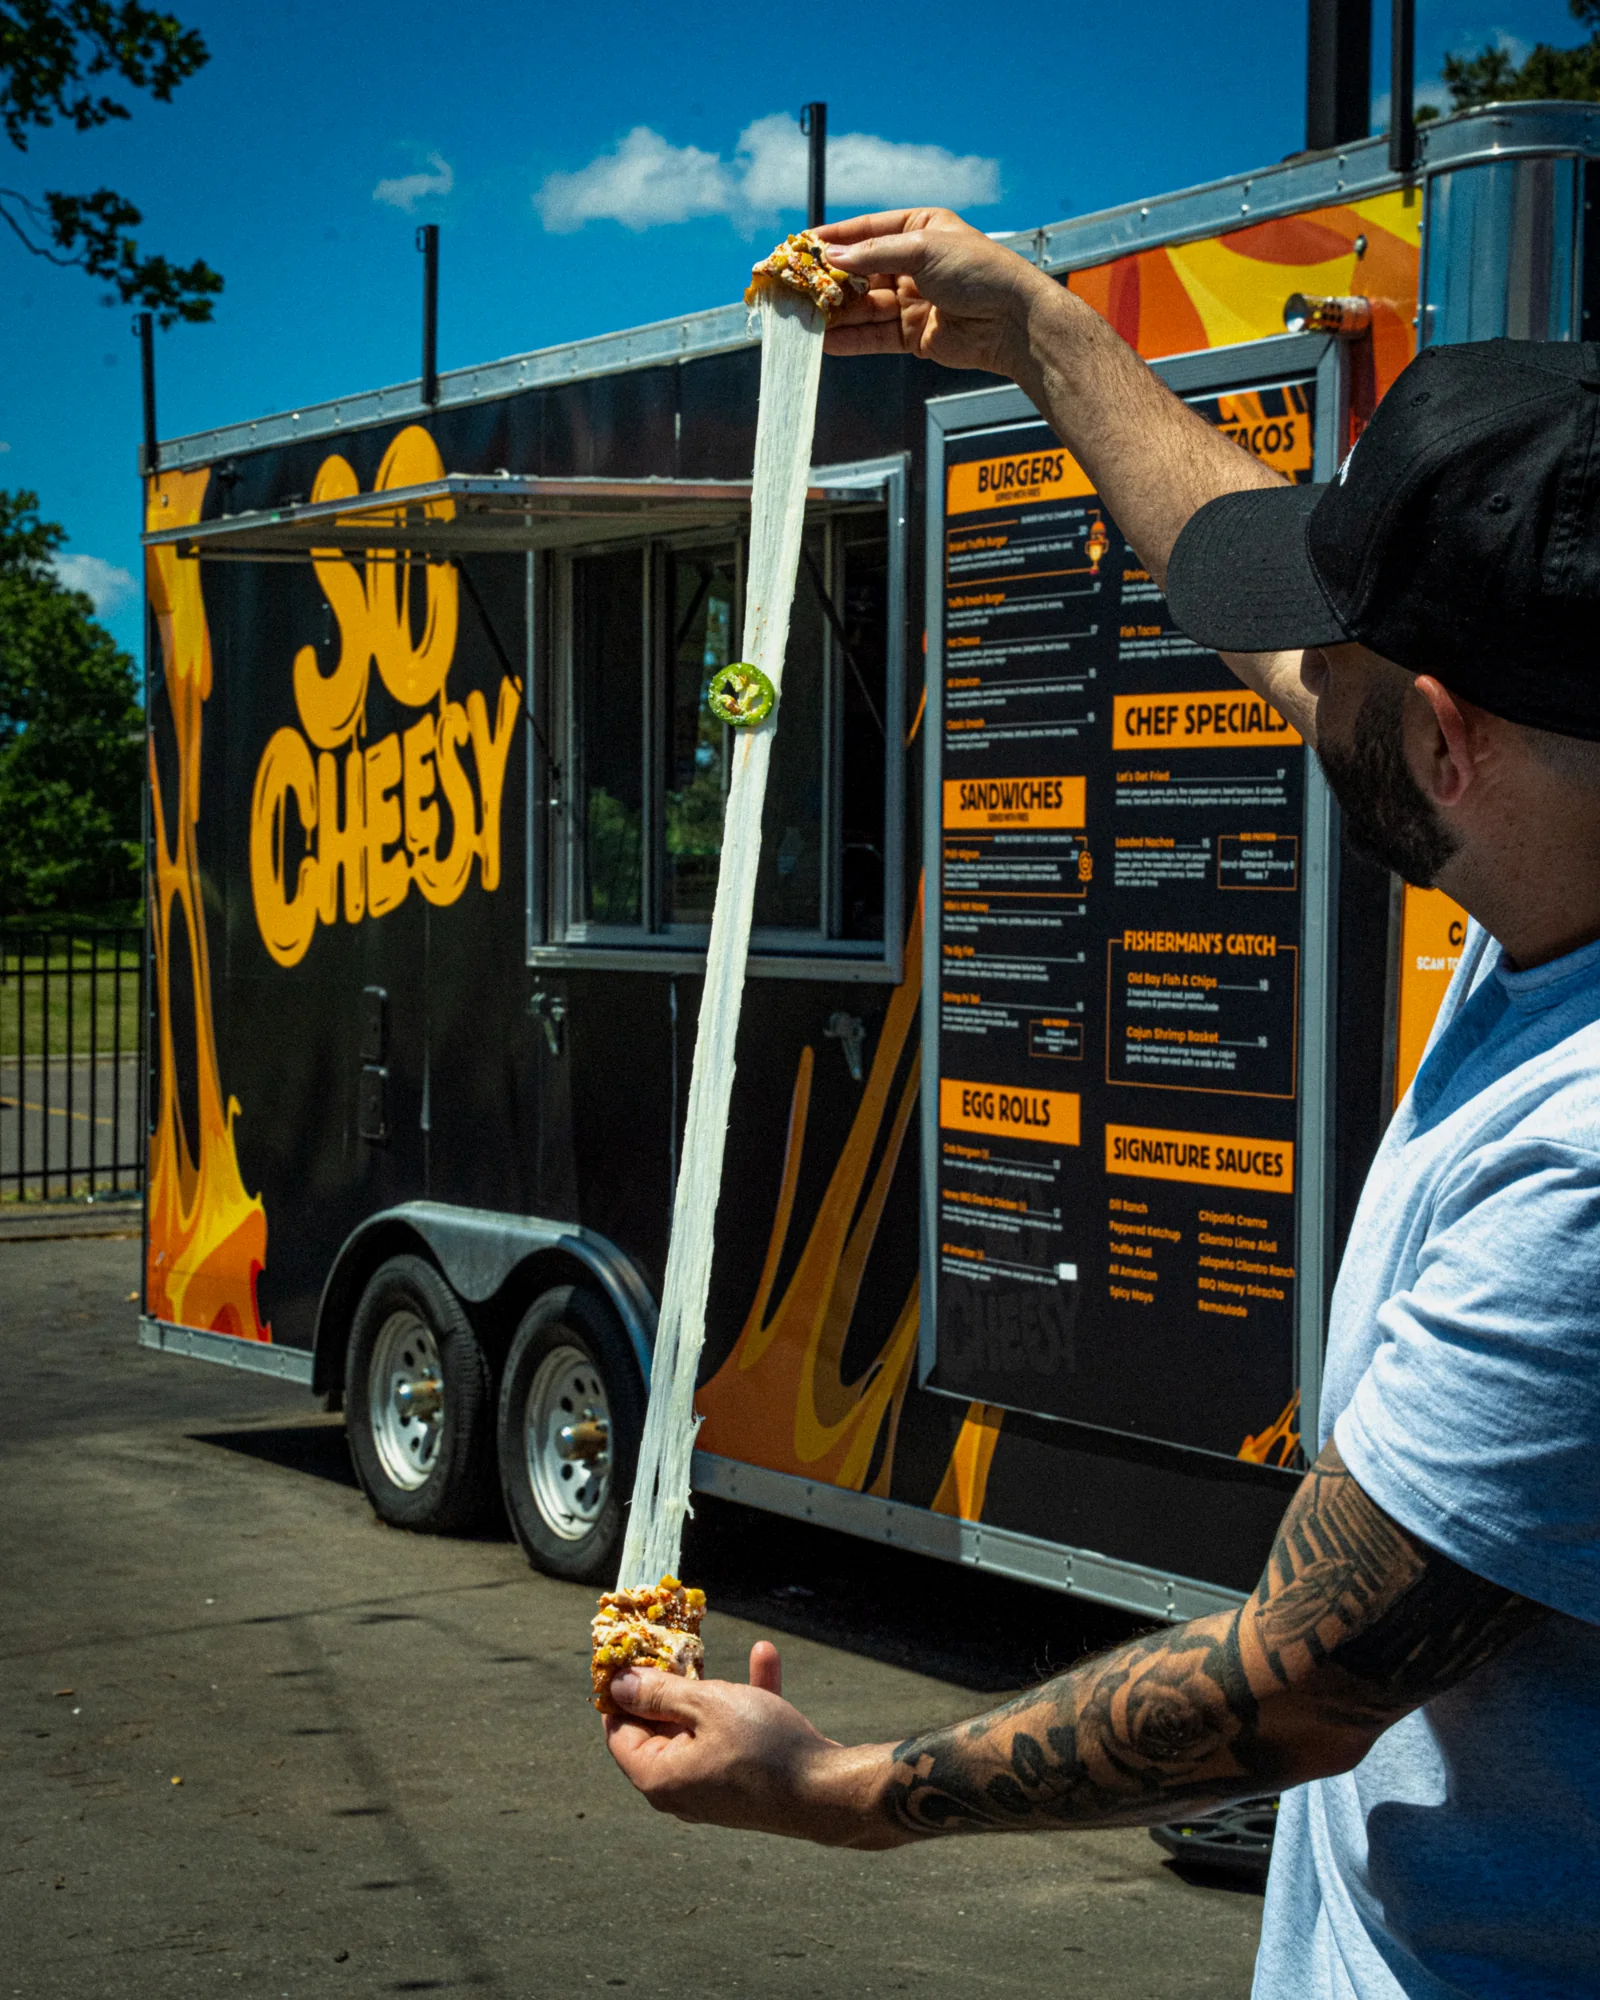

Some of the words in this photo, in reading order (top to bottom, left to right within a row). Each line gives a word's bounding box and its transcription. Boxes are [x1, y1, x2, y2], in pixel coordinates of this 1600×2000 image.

[977, 454, 1065, 493] BURGERS
[292, 424, 458, 749] SO
[1125, 705, 1179, 736] CHEF
[1185, 703, 1289, 735] SPECIALS
[960, 781, 1063, 811] SANDWICHES
[250, 675, 523, 968] CHEESY
[1241, 849, 1267, 859] Chicken
[1123, 929, 1223, 955] FISHERMAN'S
[1226, 933, 1277, 957] CATCH
[1416, 956, 1445, 971] SCAN
[1127, 972, 1143, 984] Old
[1144, 972, 1161, 988] Bay
[1162, 973, 1181, 986] Fish
[1182, 974, 1189, 986] &
[1190, 975, 1218, 990] Chips
[1126, 1026, 1152, 1041] Cajun
[1154, 1028, 1186, 1044] Shrimp
[1187, 1030, 1219, 1043] Basket
[962, 1089, 994, 1120] EGG
[1000, 1094, 1051, 1127] ROLLS
[1113, 1136, 1211, 1169] SIGNATURE
[1215, 1147, 1283, 1177] SAUCES
[1123, 1200, 1148, 1214] Ranch
[1198, 1210, 1235, 1226] Chipotle
[1236, 1214, 1268, 1229] Crema
[1108, 1220, 1146, 1236] Peppered
[1147, 1226, 1181, 1243] Ketchup
[1109, 1241, 1133, 1256] Truffle
[1135, 1245, 1153, 1259] Aioli
[1198, 1232, 1233, 1247] Cilantro
[1234, 1236, 1256, 1251] Lime
[1257, 1239, 1278, 1253] Aioli
[1108, 1263, 1119, 1275] All
[1120, 1265, 1158, 1281] American
[1235, 1259, 1268, 1275] Cilantro
[1269, 1264, 1296, 1279] Ranch
[1109, 1285, 1130, 1302] Spicy
[1131, 1289, 1154, 1305] Mayo
[1198, 1276, 1216, 1291] BBQ
[1217, 1280, 1246, 1298] Honey
[1246, 1283, 1285, 1300] Sriracha
[1198, 1299, 1248, 1318] Remoulade
